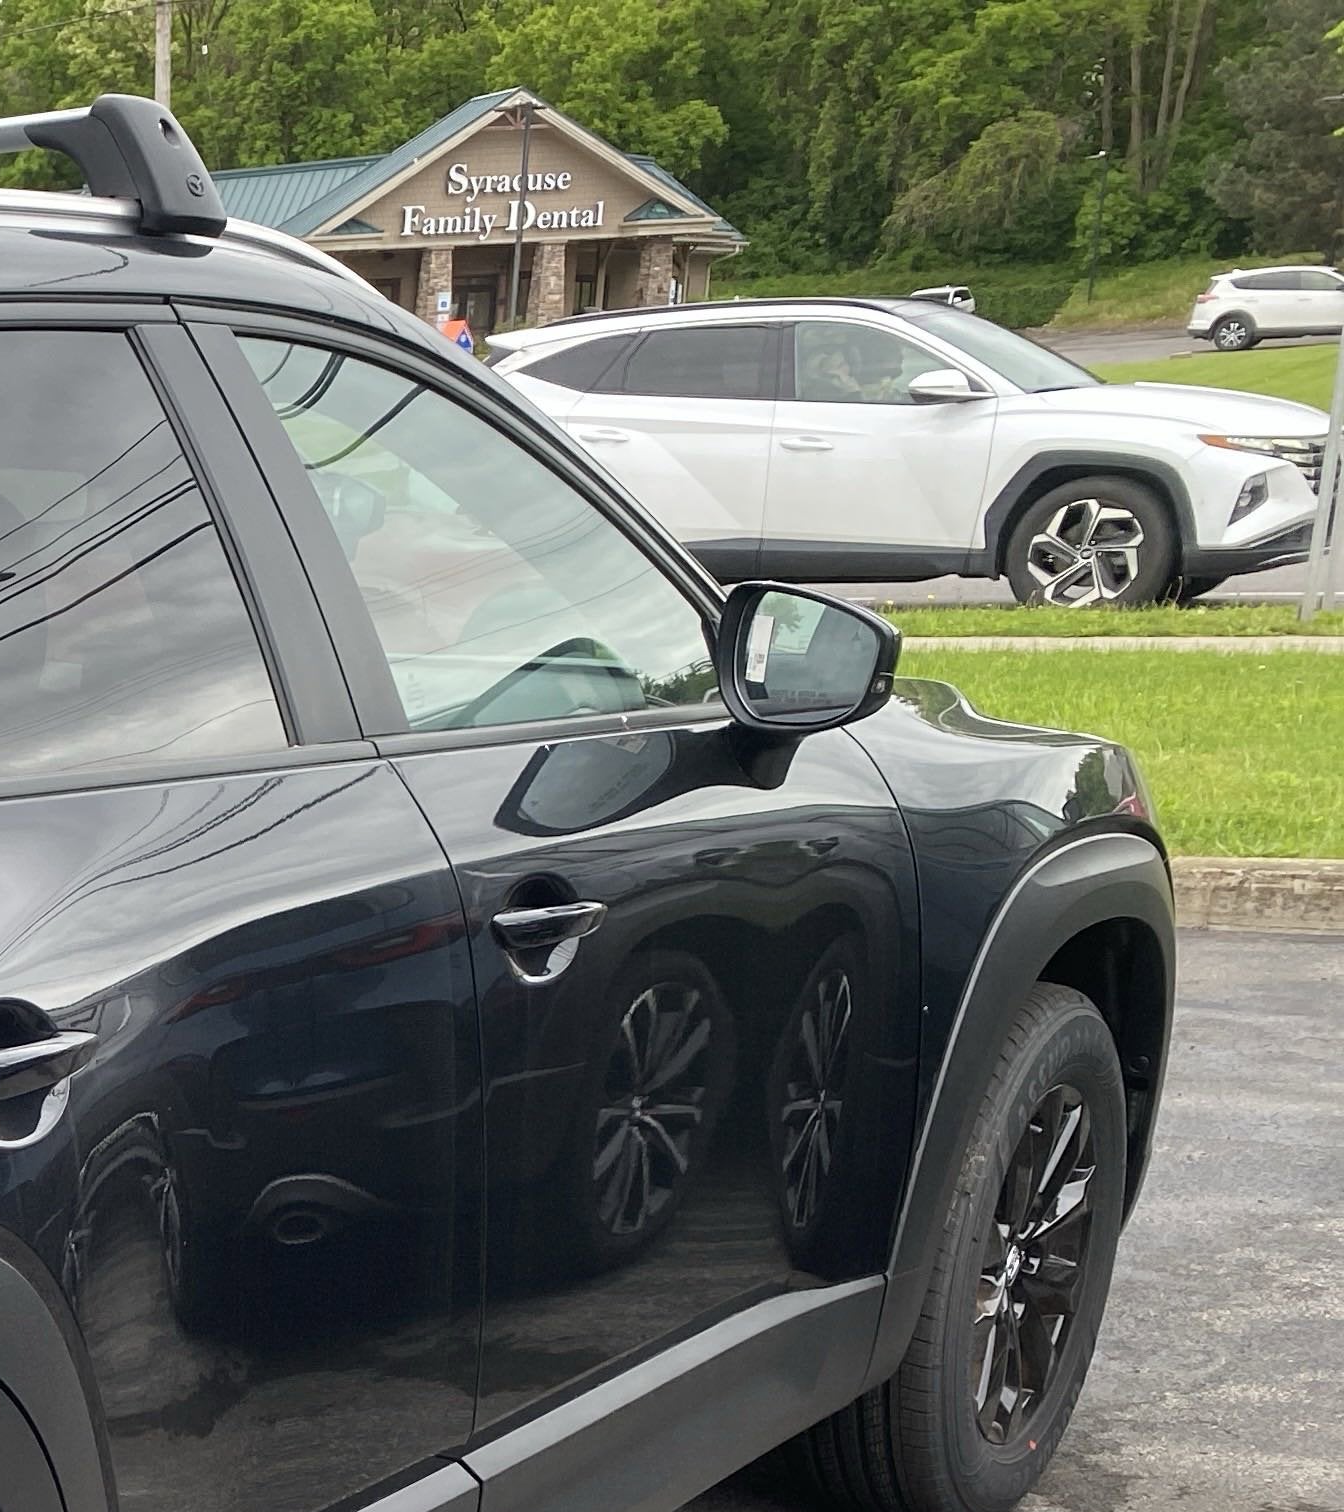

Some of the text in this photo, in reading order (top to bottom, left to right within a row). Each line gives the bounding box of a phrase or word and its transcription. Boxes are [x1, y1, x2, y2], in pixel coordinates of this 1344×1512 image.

[447, 163, 572, 202] Syracuse
[400, 200, 605, 240] Family Dental
